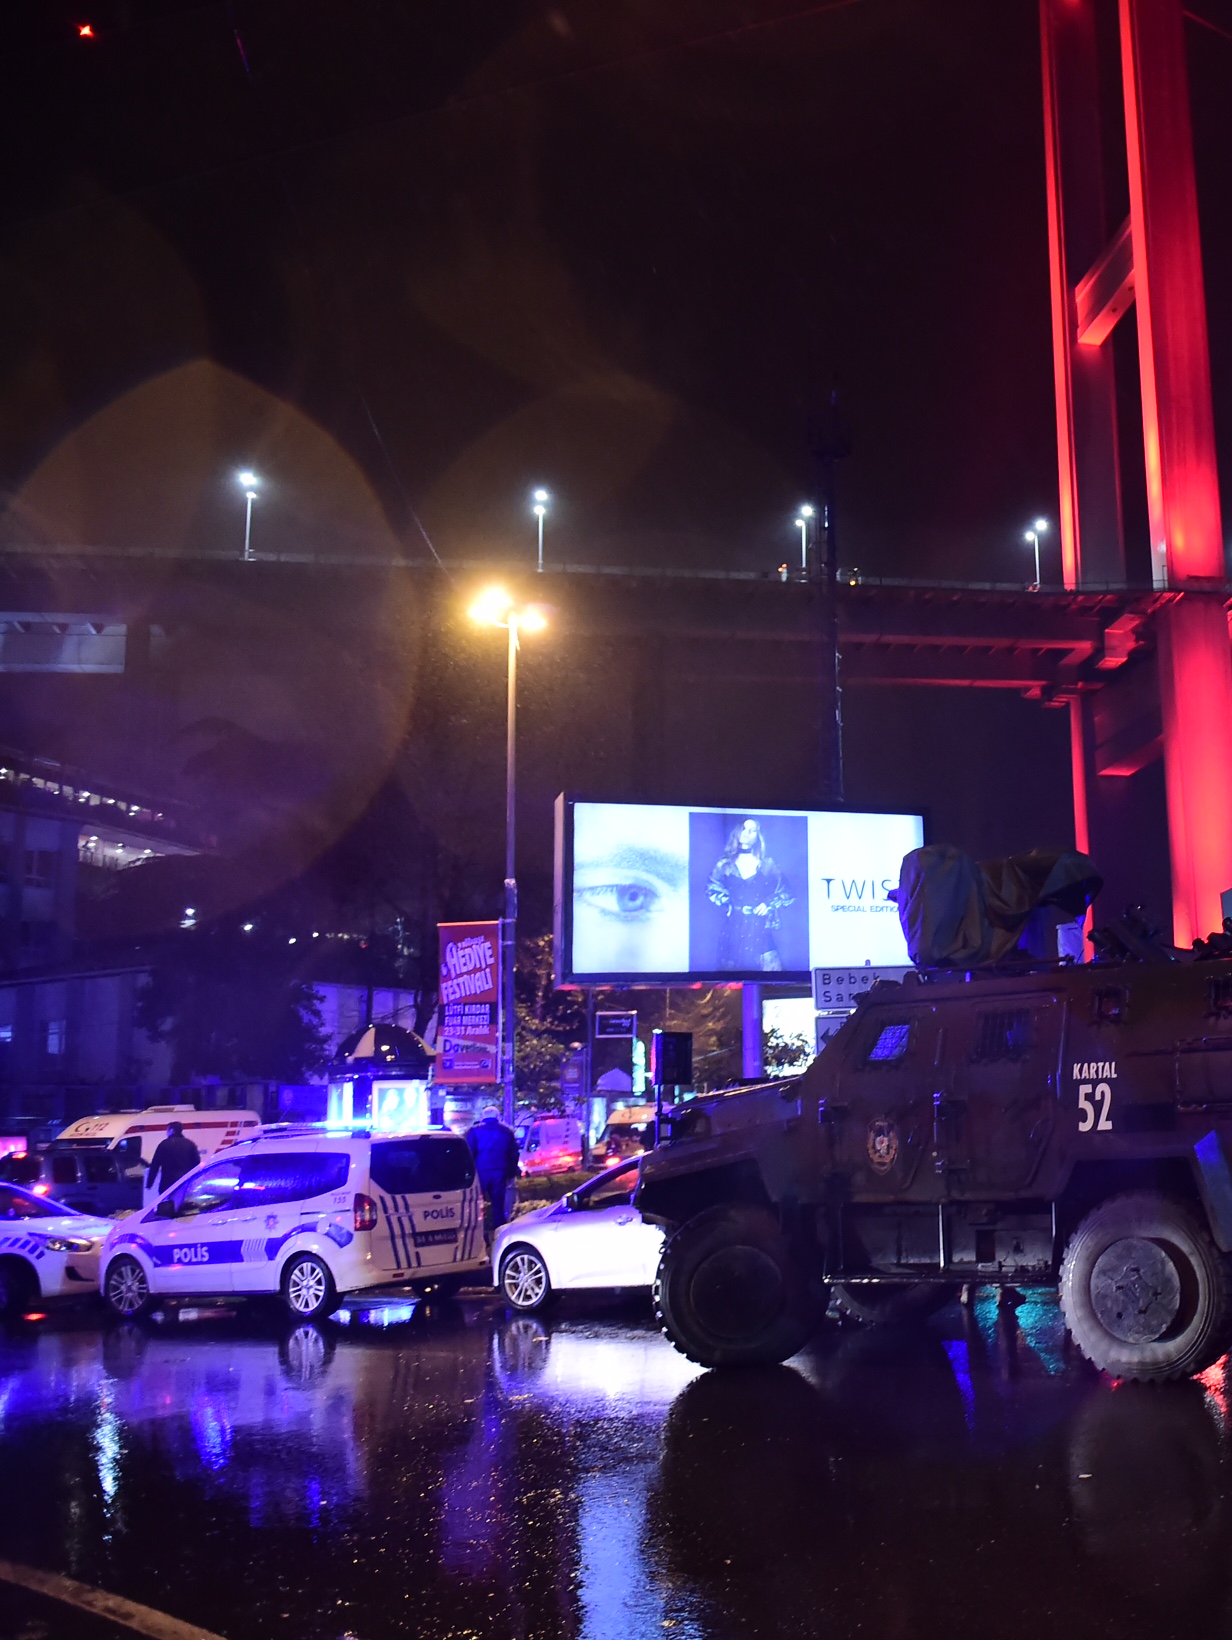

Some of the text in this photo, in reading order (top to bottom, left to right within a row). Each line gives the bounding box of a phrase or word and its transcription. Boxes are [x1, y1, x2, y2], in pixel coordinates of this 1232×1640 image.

[821, 878, 899, 901] TWIS
[831, 905, 899, 913] SPECIAL EDITIO
[1072, 1061, 1118, 1080] KARTAL
[1078, 1082, 1113, 1132] 52
[423, 1206, 456, 1220] POLİS
[172, 1244, 210, 1263] POLİS
